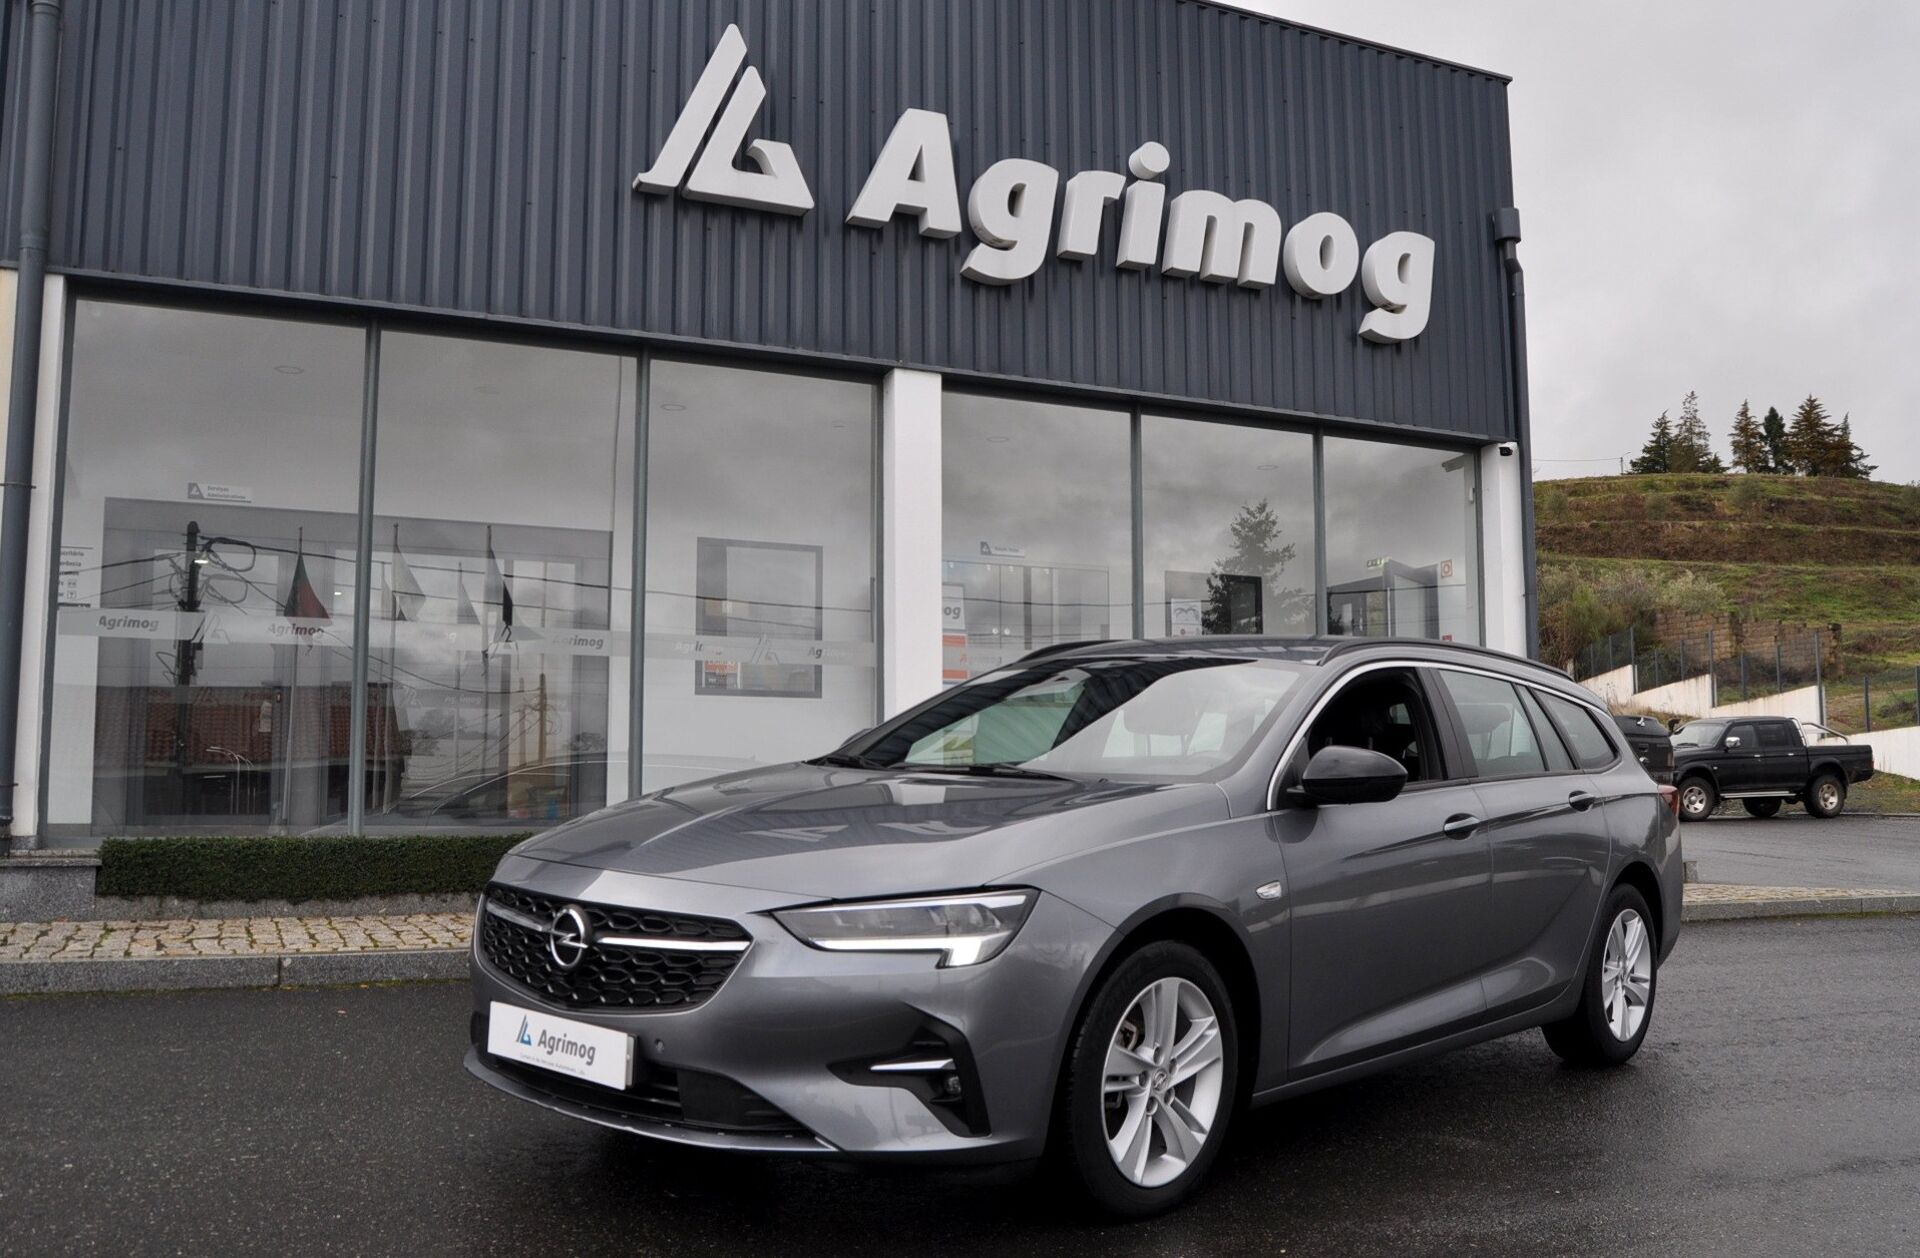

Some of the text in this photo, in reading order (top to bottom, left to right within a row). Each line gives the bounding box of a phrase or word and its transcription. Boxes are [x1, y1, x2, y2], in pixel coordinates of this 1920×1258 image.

[845, 108, 1436, 344] Agrimog
[98, 615, 160, 632] Agrimog
[552, 634, 604, 650] rimog
[538, 1029, 596, 1066] Agrimog
